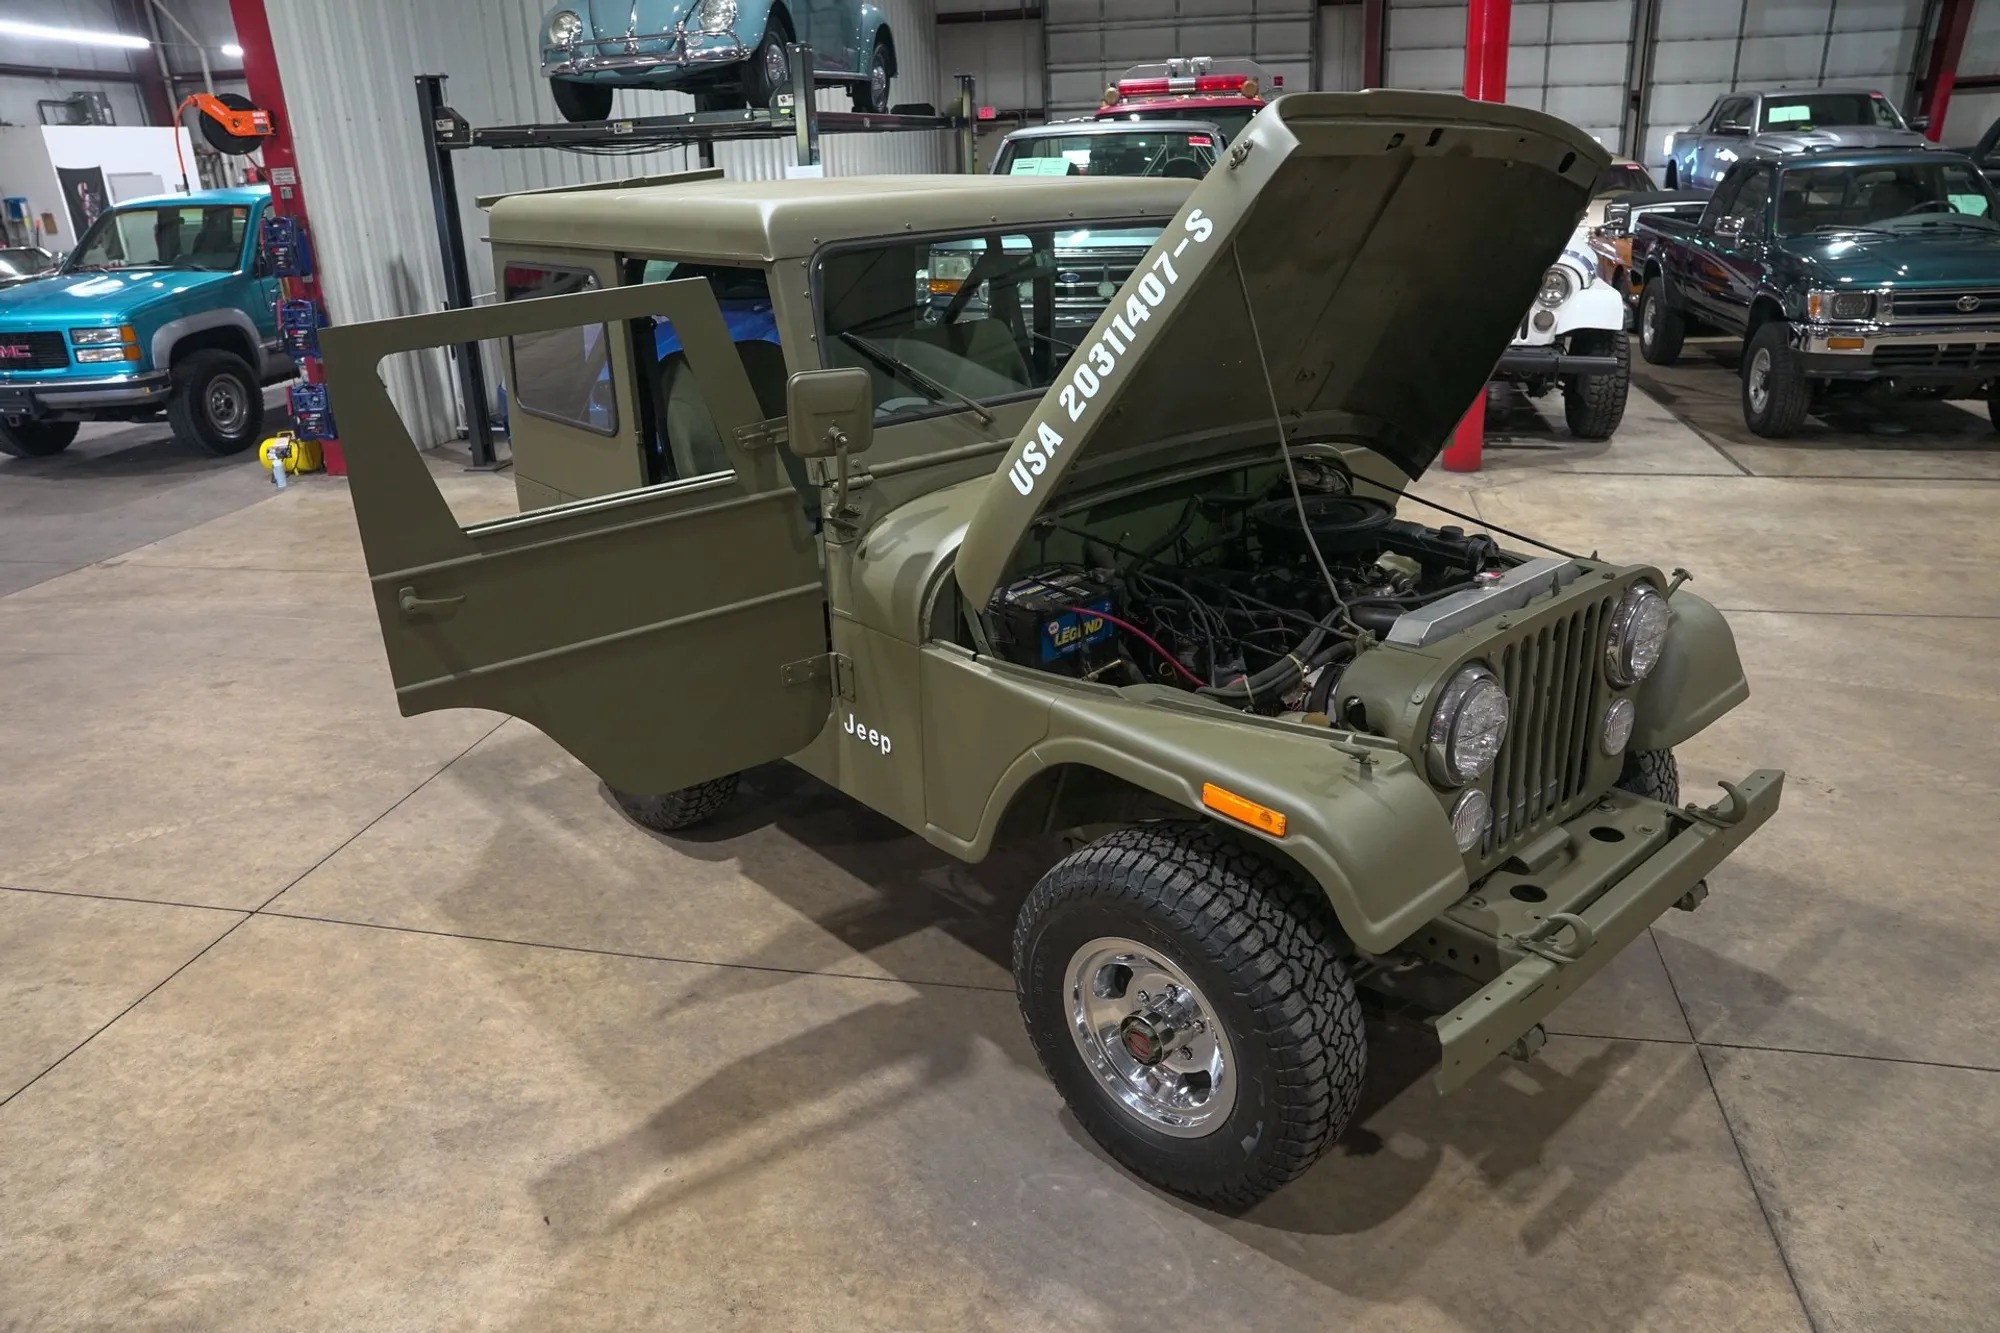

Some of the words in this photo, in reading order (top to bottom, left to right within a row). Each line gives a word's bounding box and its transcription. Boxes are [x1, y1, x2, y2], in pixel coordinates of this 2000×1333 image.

[1008, 421, 1064, 496] USA
[1059, 208, 1213, 422] 20311407-S
[843, 713, 891, 755] Jeep
